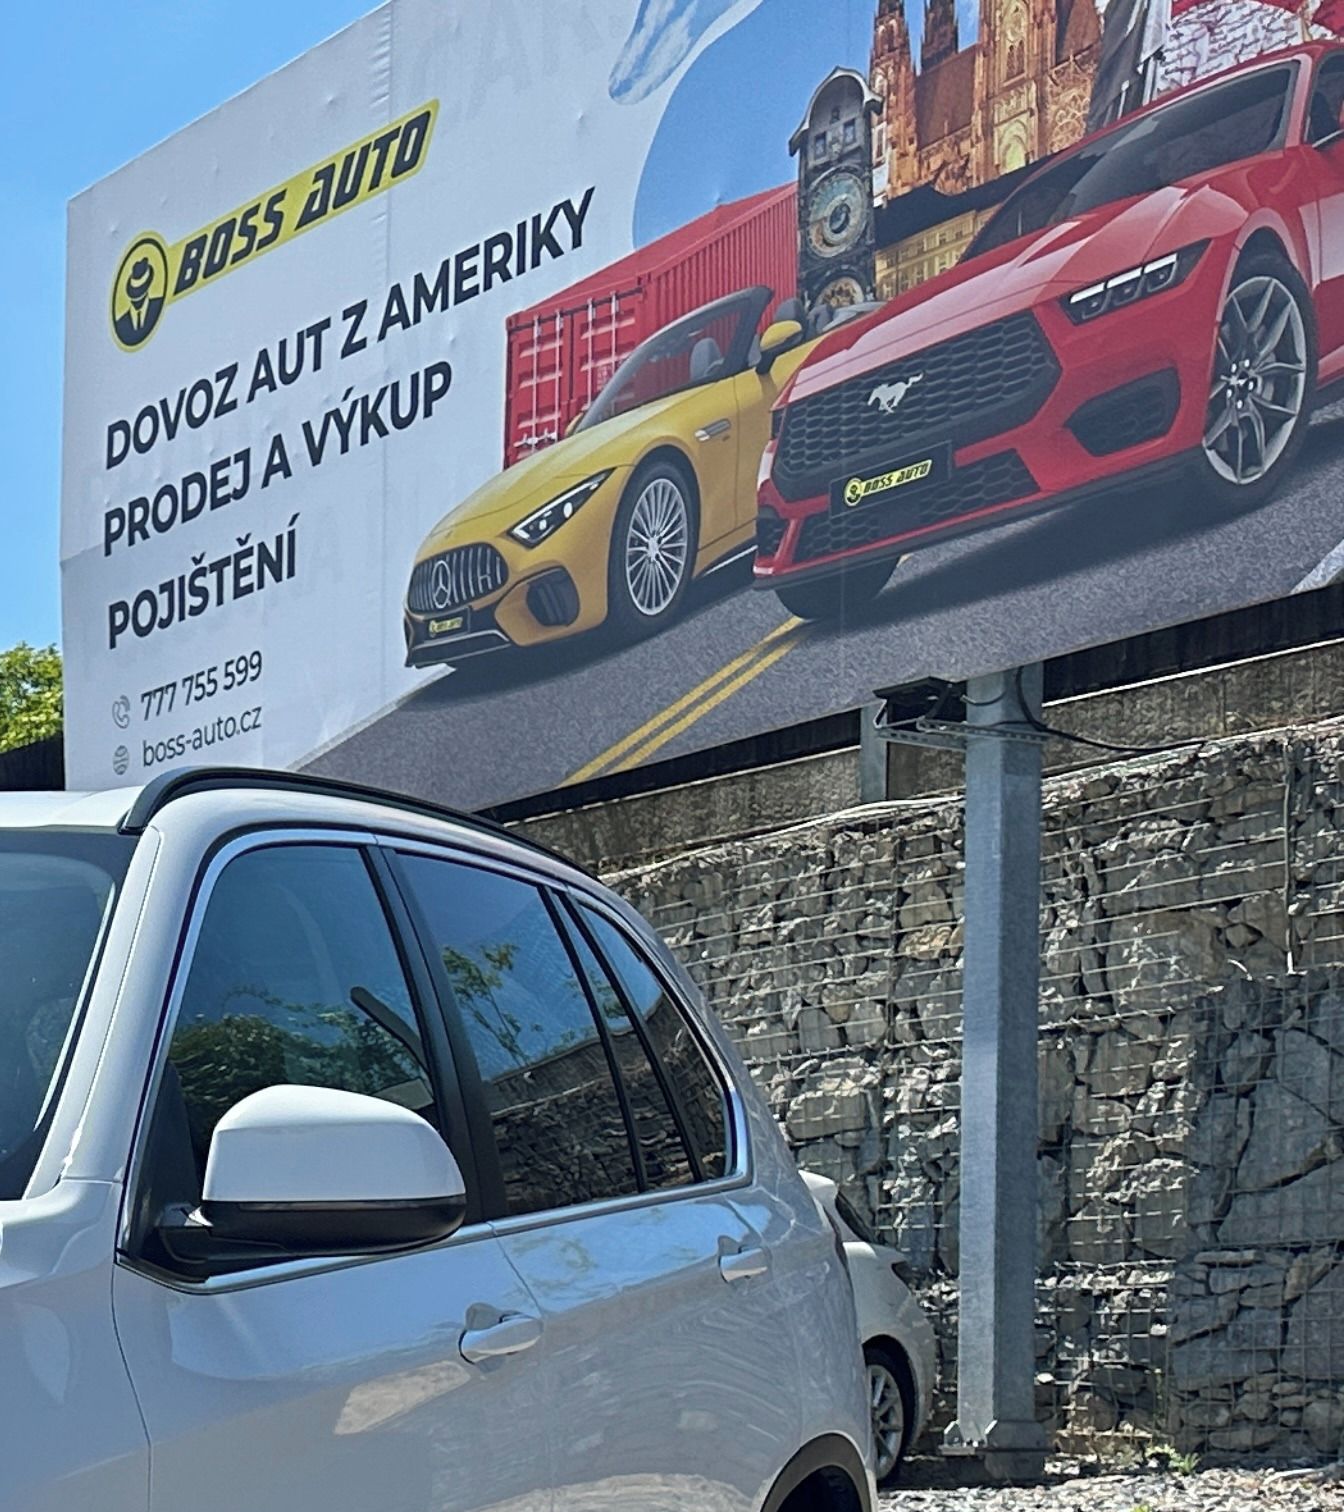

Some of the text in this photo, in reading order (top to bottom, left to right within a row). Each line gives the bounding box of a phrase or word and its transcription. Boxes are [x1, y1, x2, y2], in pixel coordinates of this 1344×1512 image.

[173, 110, 431, 296] BOSS AUTO
[106, 186, 596, 470] DOVOZ AUT Z AMERIKY
[104, 361, 452, 557] PRODEJ A VÝKUP
[108, 512, 300, 650] POJIŠTĚNÍ
[140, 650, 263, 721] 777 755 599
[142, 706, 263, 767] boss-auto.cz
